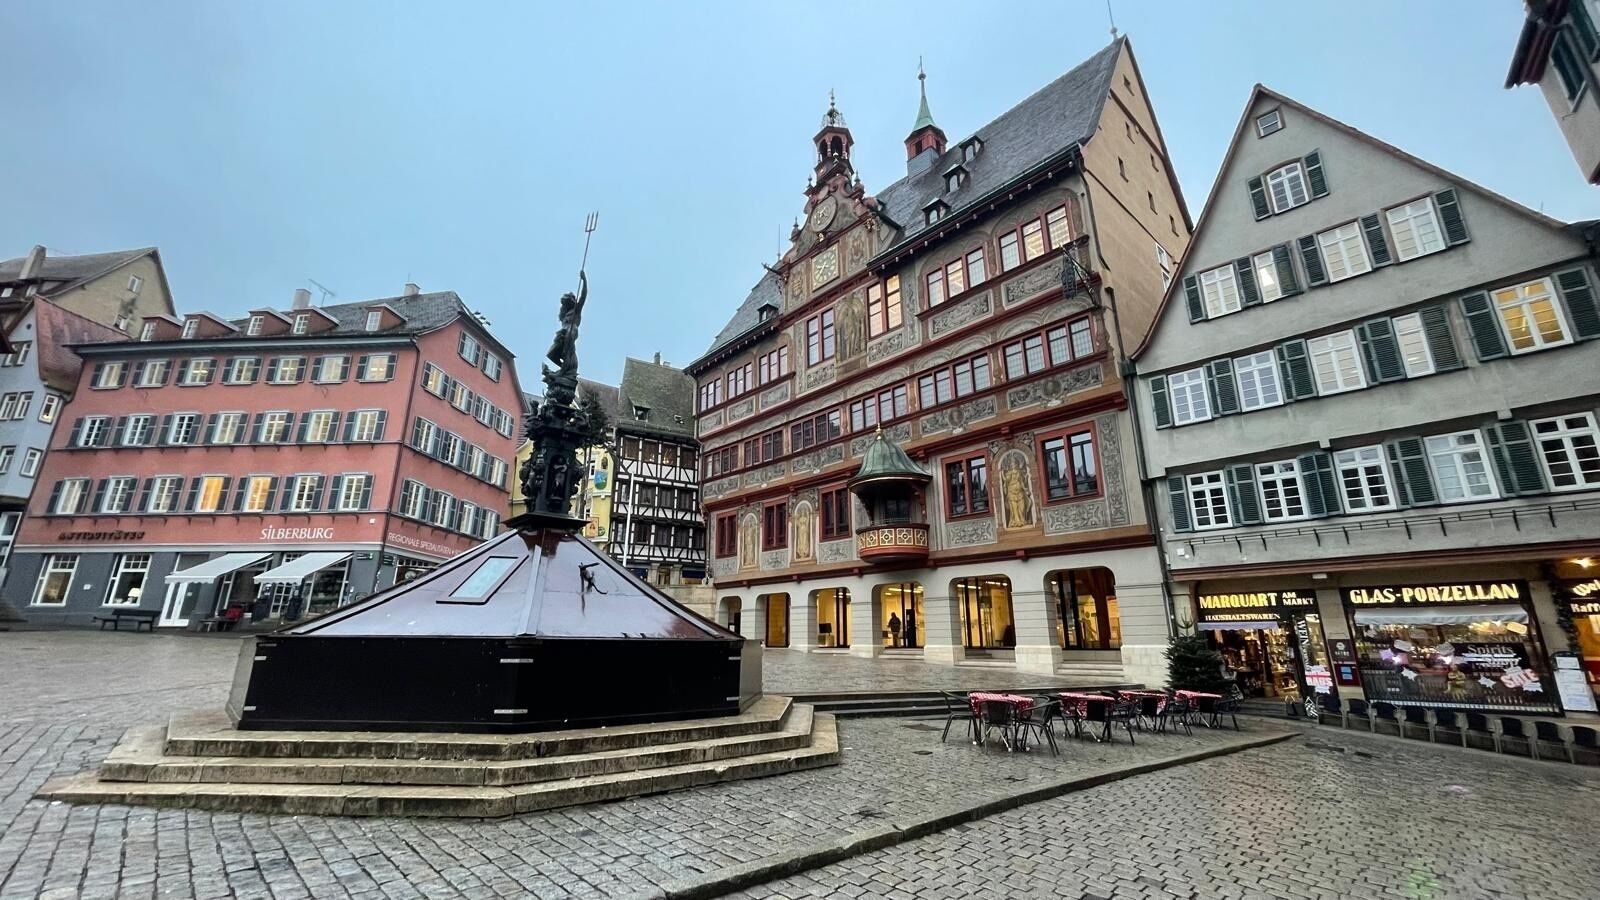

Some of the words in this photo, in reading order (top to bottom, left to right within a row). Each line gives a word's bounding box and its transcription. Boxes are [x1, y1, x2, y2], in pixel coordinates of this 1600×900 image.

[387, 533, 419, 547] REGIONALE
[1199, 593, 1278, 609] MARQUART
[1350, 584, 1519, 603] GLAS-PORZELLAN
[1205, 613, 1281, 621] HAUSHALTSWAREN
